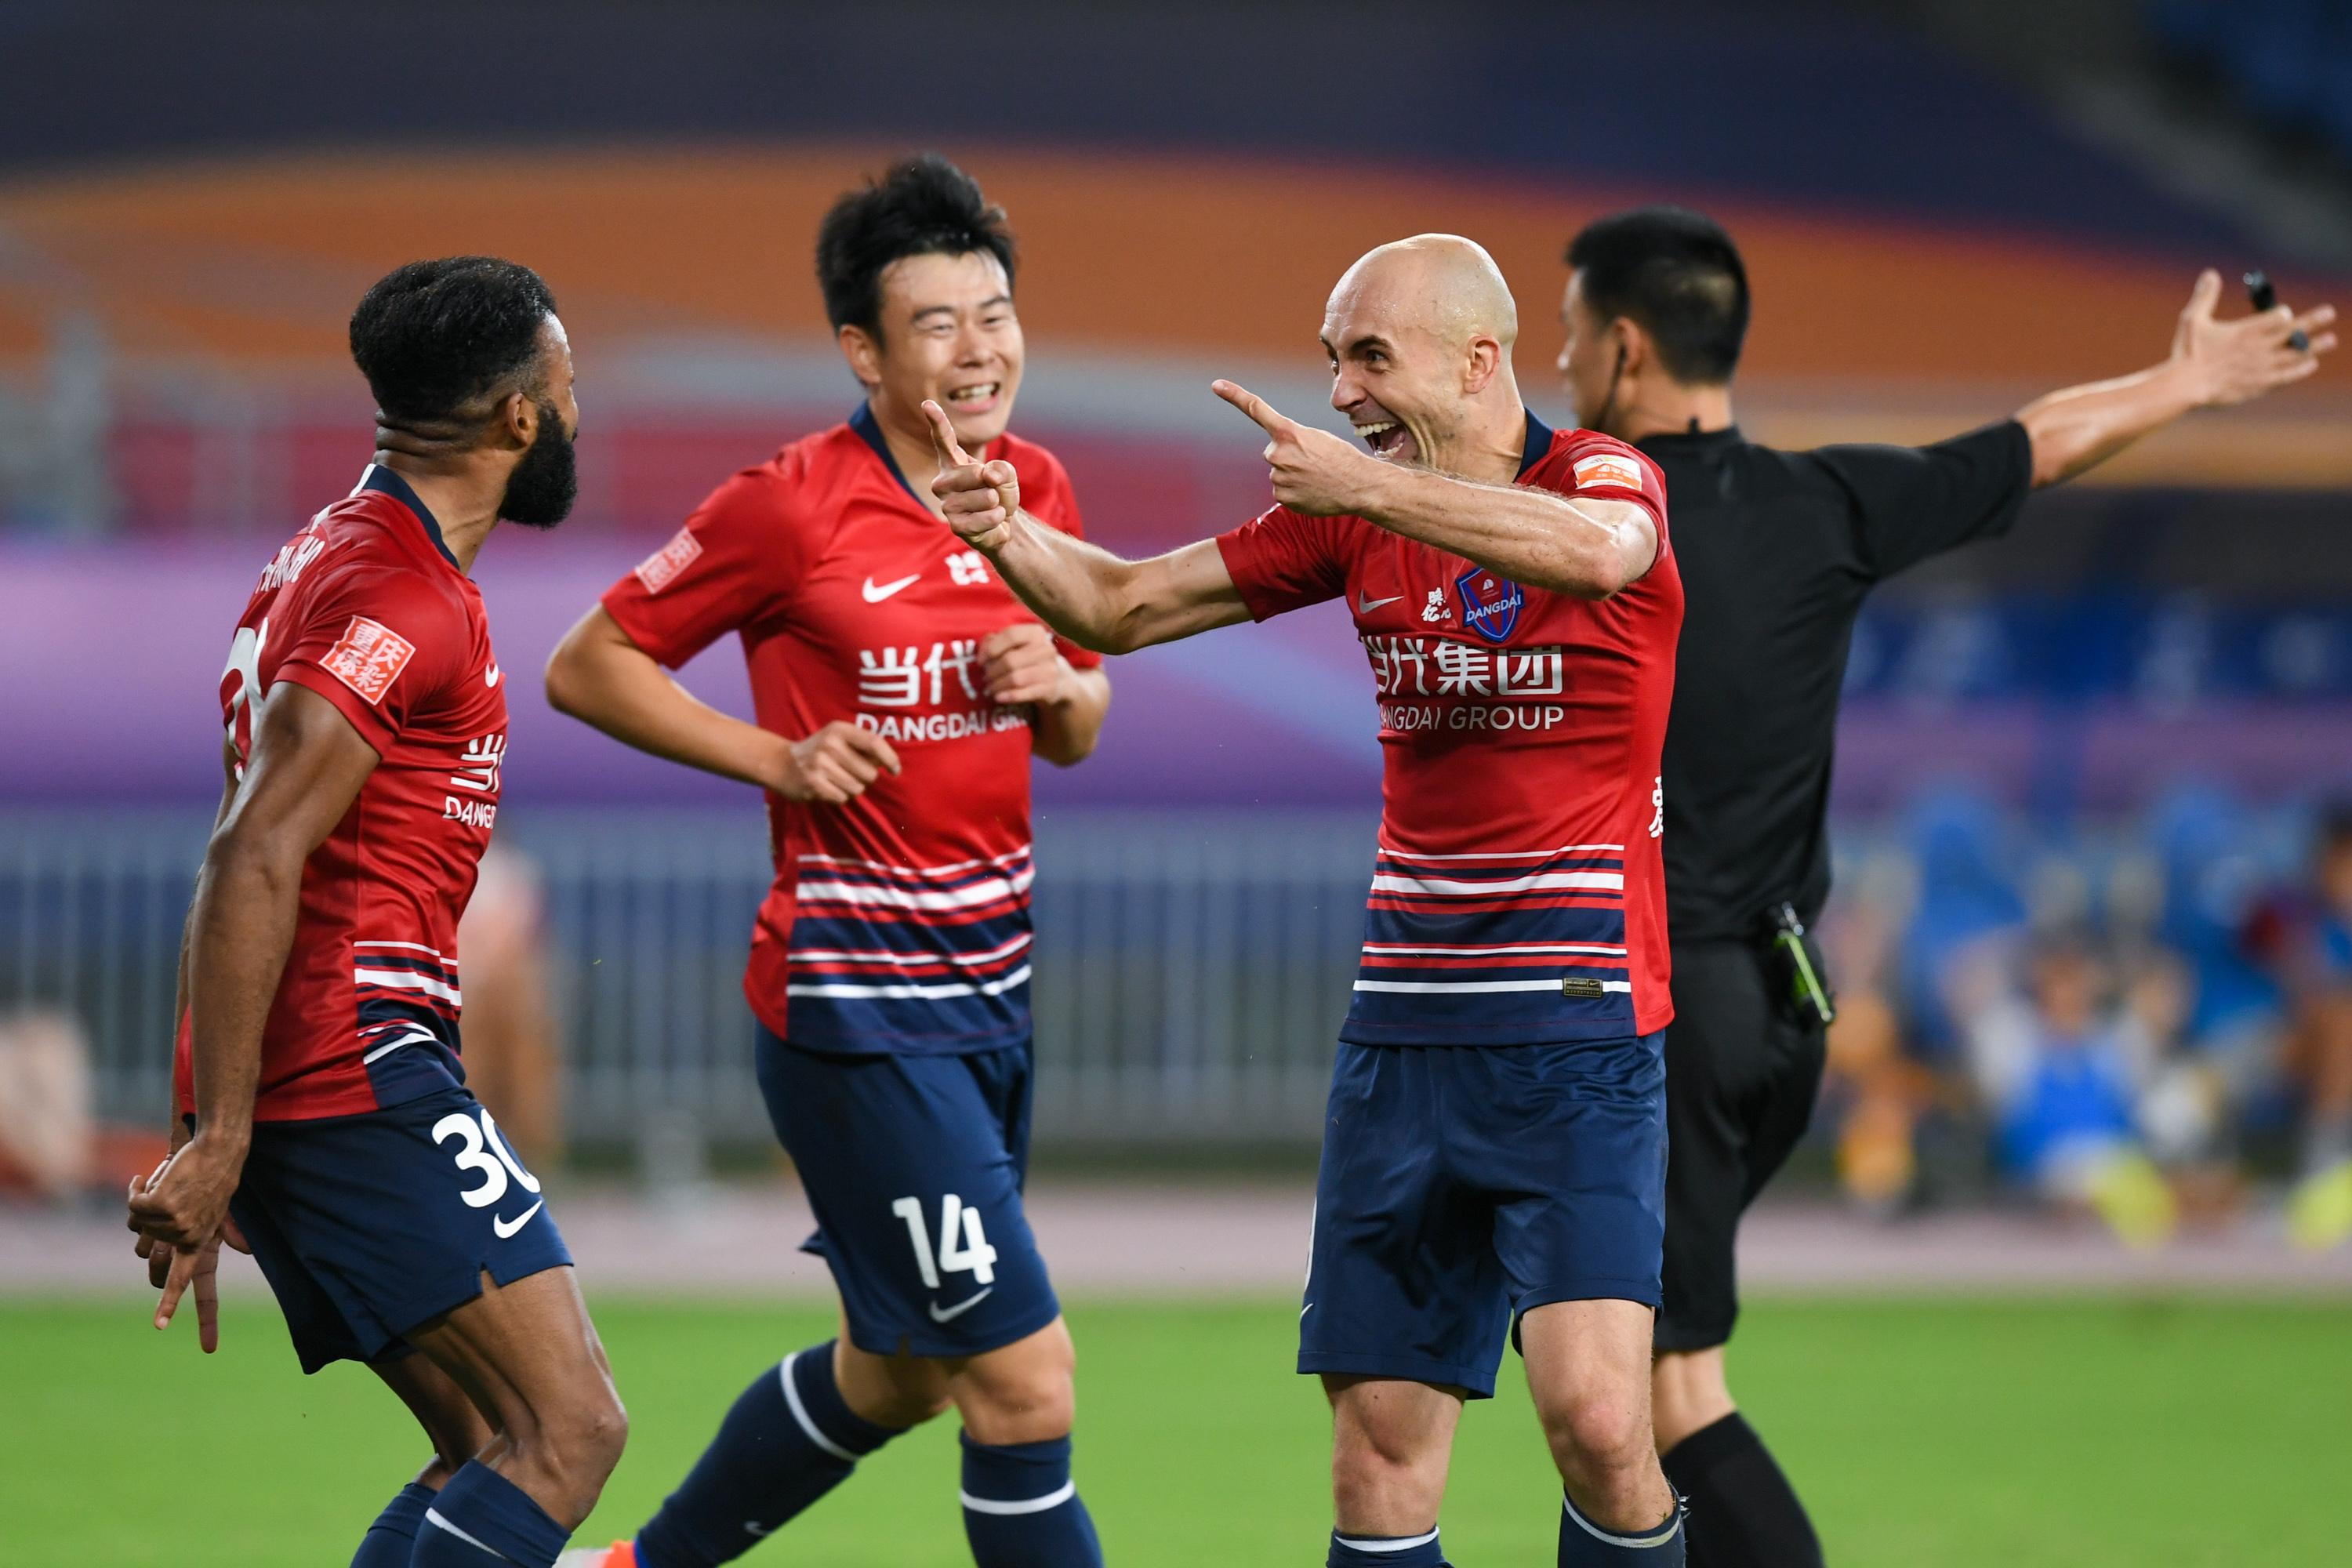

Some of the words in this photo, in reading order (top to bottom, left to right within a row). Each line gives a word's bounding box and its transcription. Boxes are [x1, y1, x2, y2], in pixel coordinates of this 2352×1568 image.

[1465, 594, 1521, 622] DANGDAI
[349, 623, 406, 671] 重庆
[1381, 704, 1441, 730] ANGDAI
[1449, 706, 1564, 730] GROUP
[892, 1193, 997, 1288] 14
